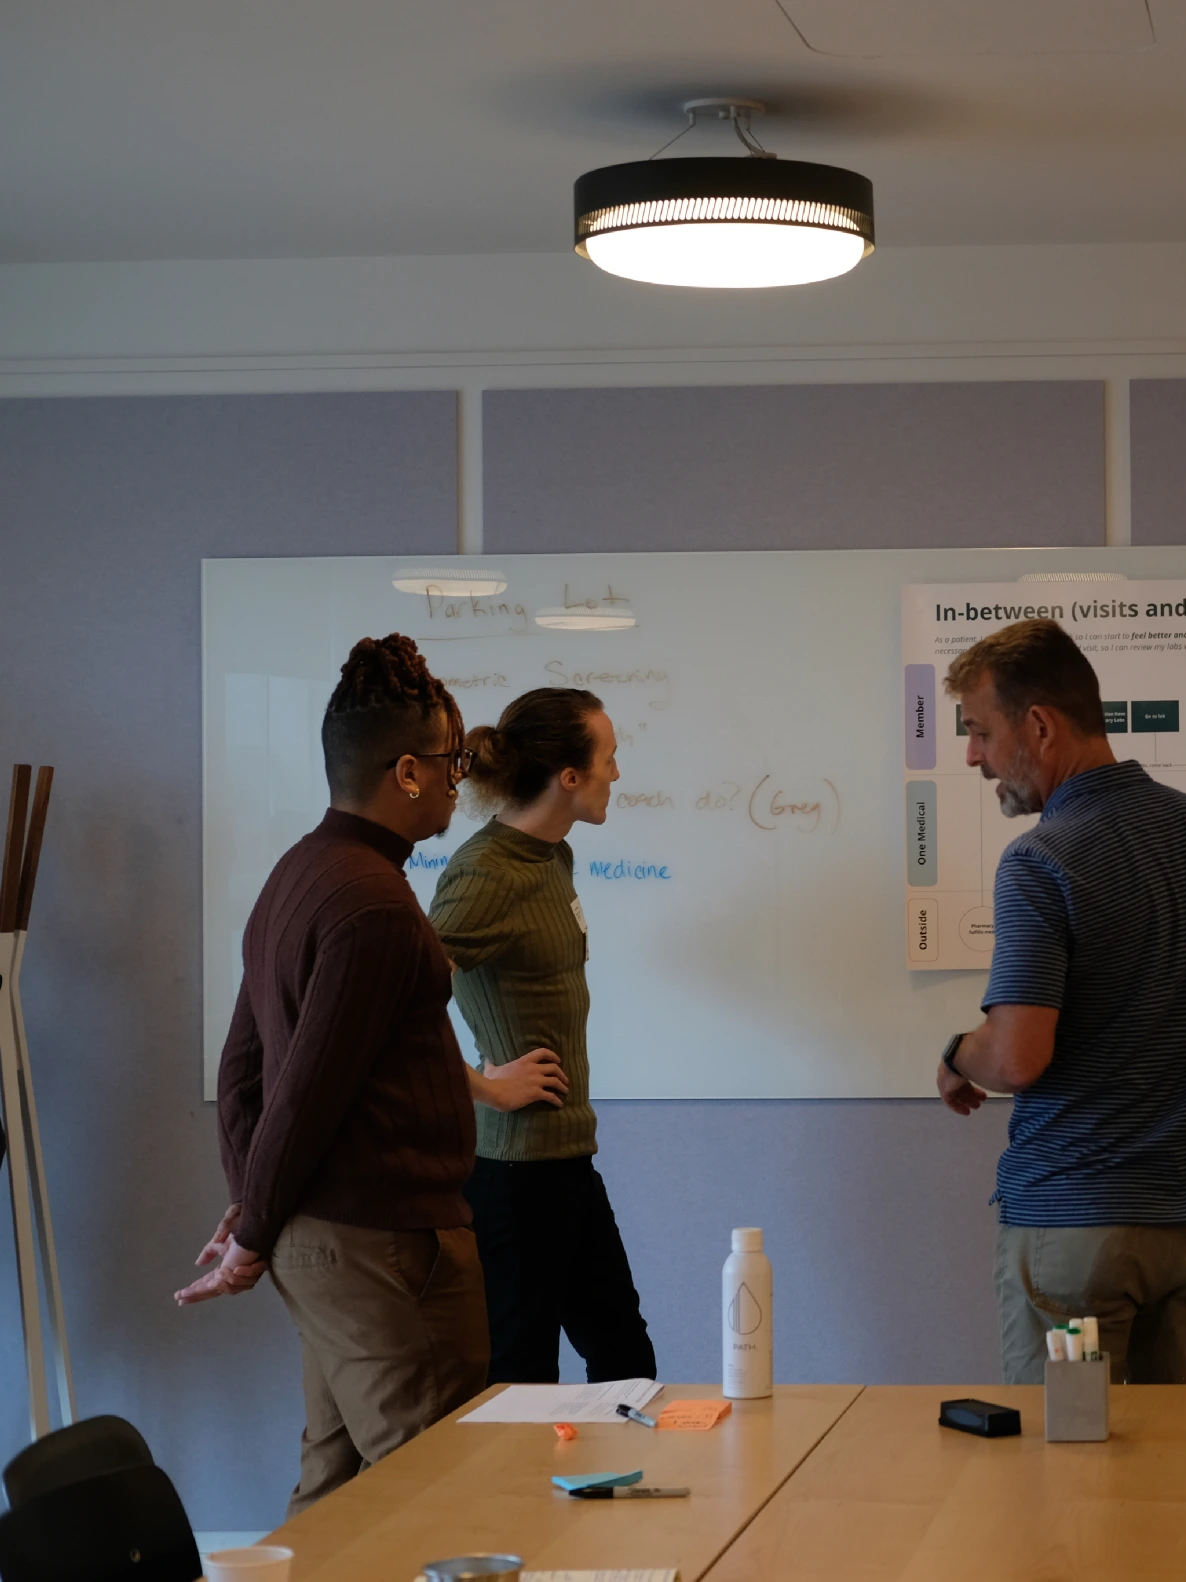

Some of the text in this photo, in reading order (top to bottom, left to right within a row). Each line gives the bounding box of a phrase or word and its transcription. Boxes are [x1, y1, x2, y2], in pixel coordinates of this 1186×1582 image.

[425, 583, 630, 633] Parking Lot
[936, 602, 1064, 621] In-between
[1071, 599, 1138, 622] (visits
[1131, 631, 1147, 641] feel
[1148, 631, 1172, 639] better
[915, 694, 925, 738] Member
[616, 774, 842, 837] coach do? (Greg)
[917, 801, 926, 866] One Medical
[589, 859, 672, 880] Medicine
[918, 909, 928, 950] Outside
